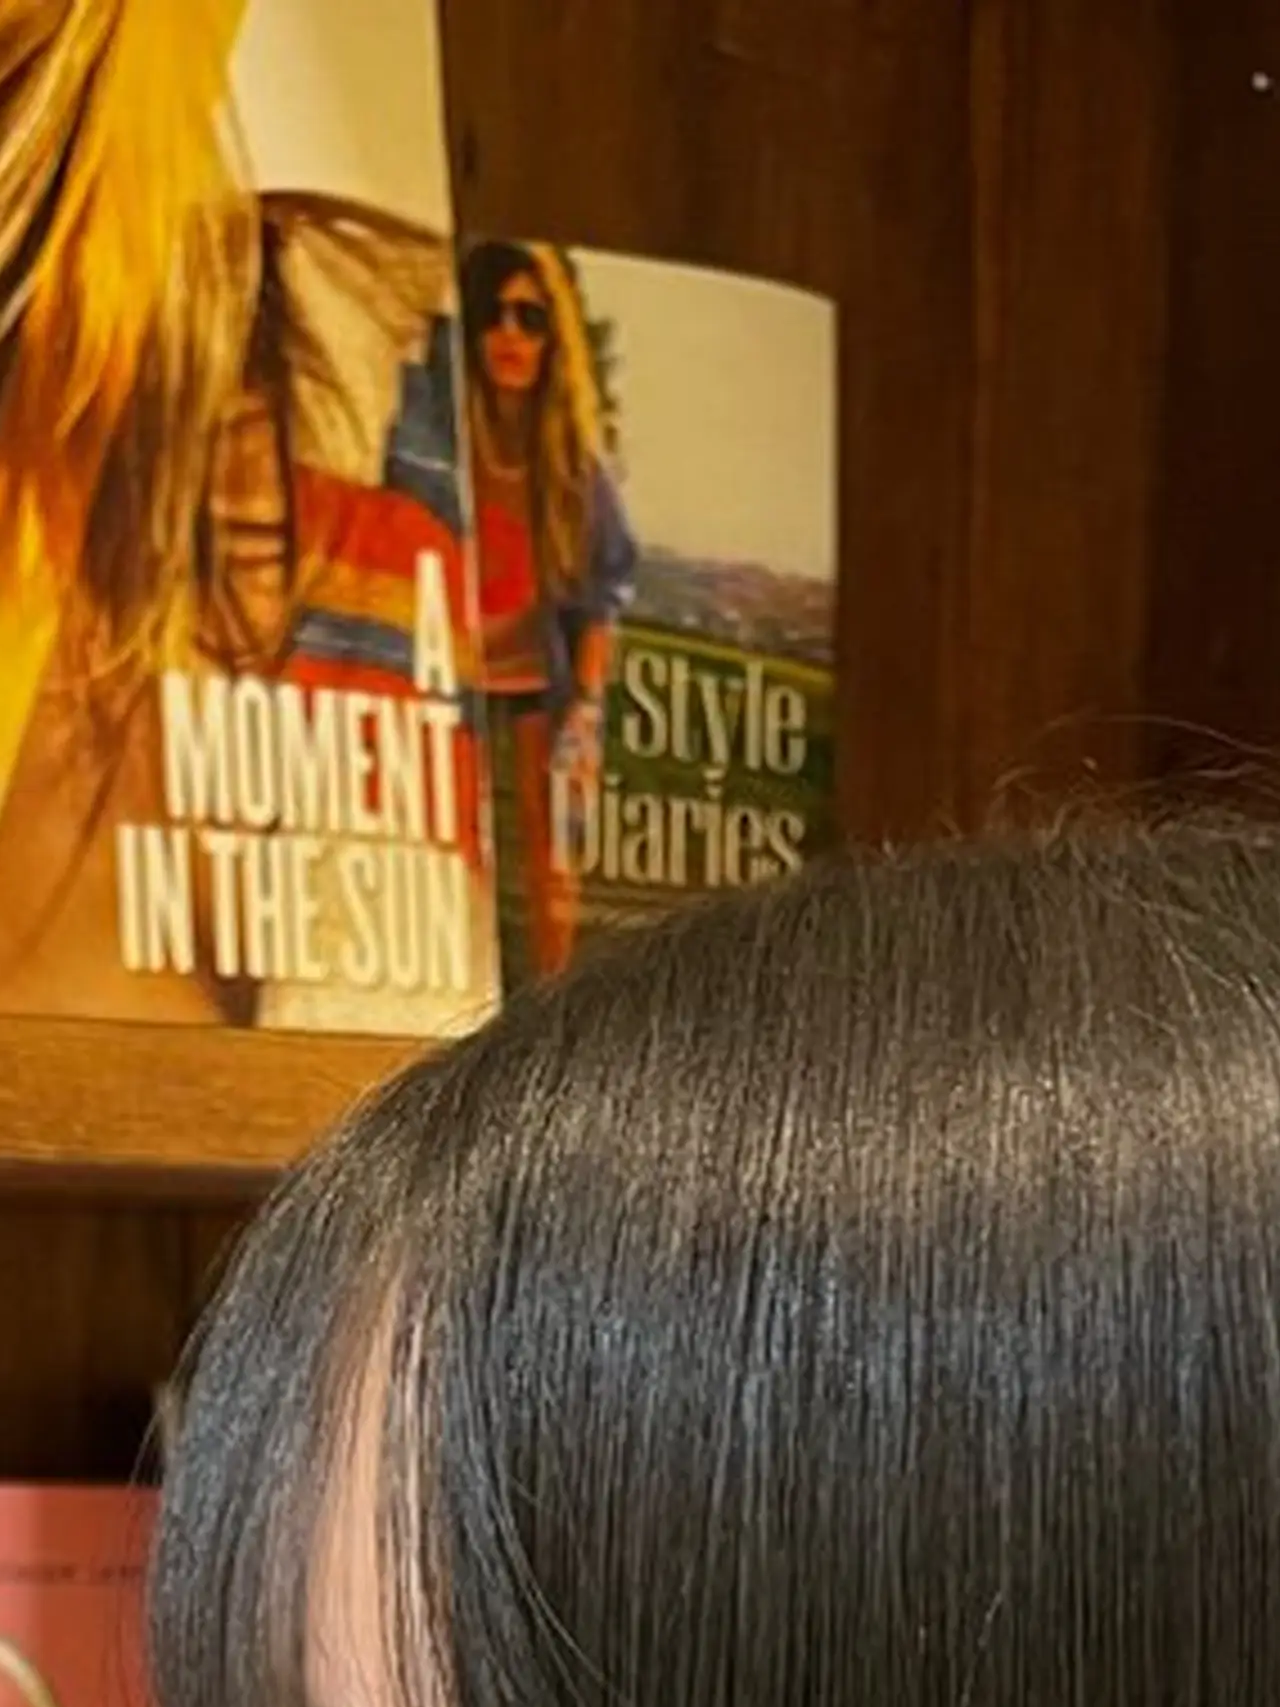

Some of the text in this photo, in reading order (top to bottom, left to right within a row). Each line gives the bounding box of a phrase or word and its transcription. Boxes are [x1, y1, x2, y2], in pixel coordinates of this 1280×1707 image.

[415, 548, 457, 696] A
[162, 670, 461, 845] MOMENT
[622, 648, 808, 785] Style
[549, 766, 806, 888] Diaries
[117, 822, 470, 990] IN THE SUN
